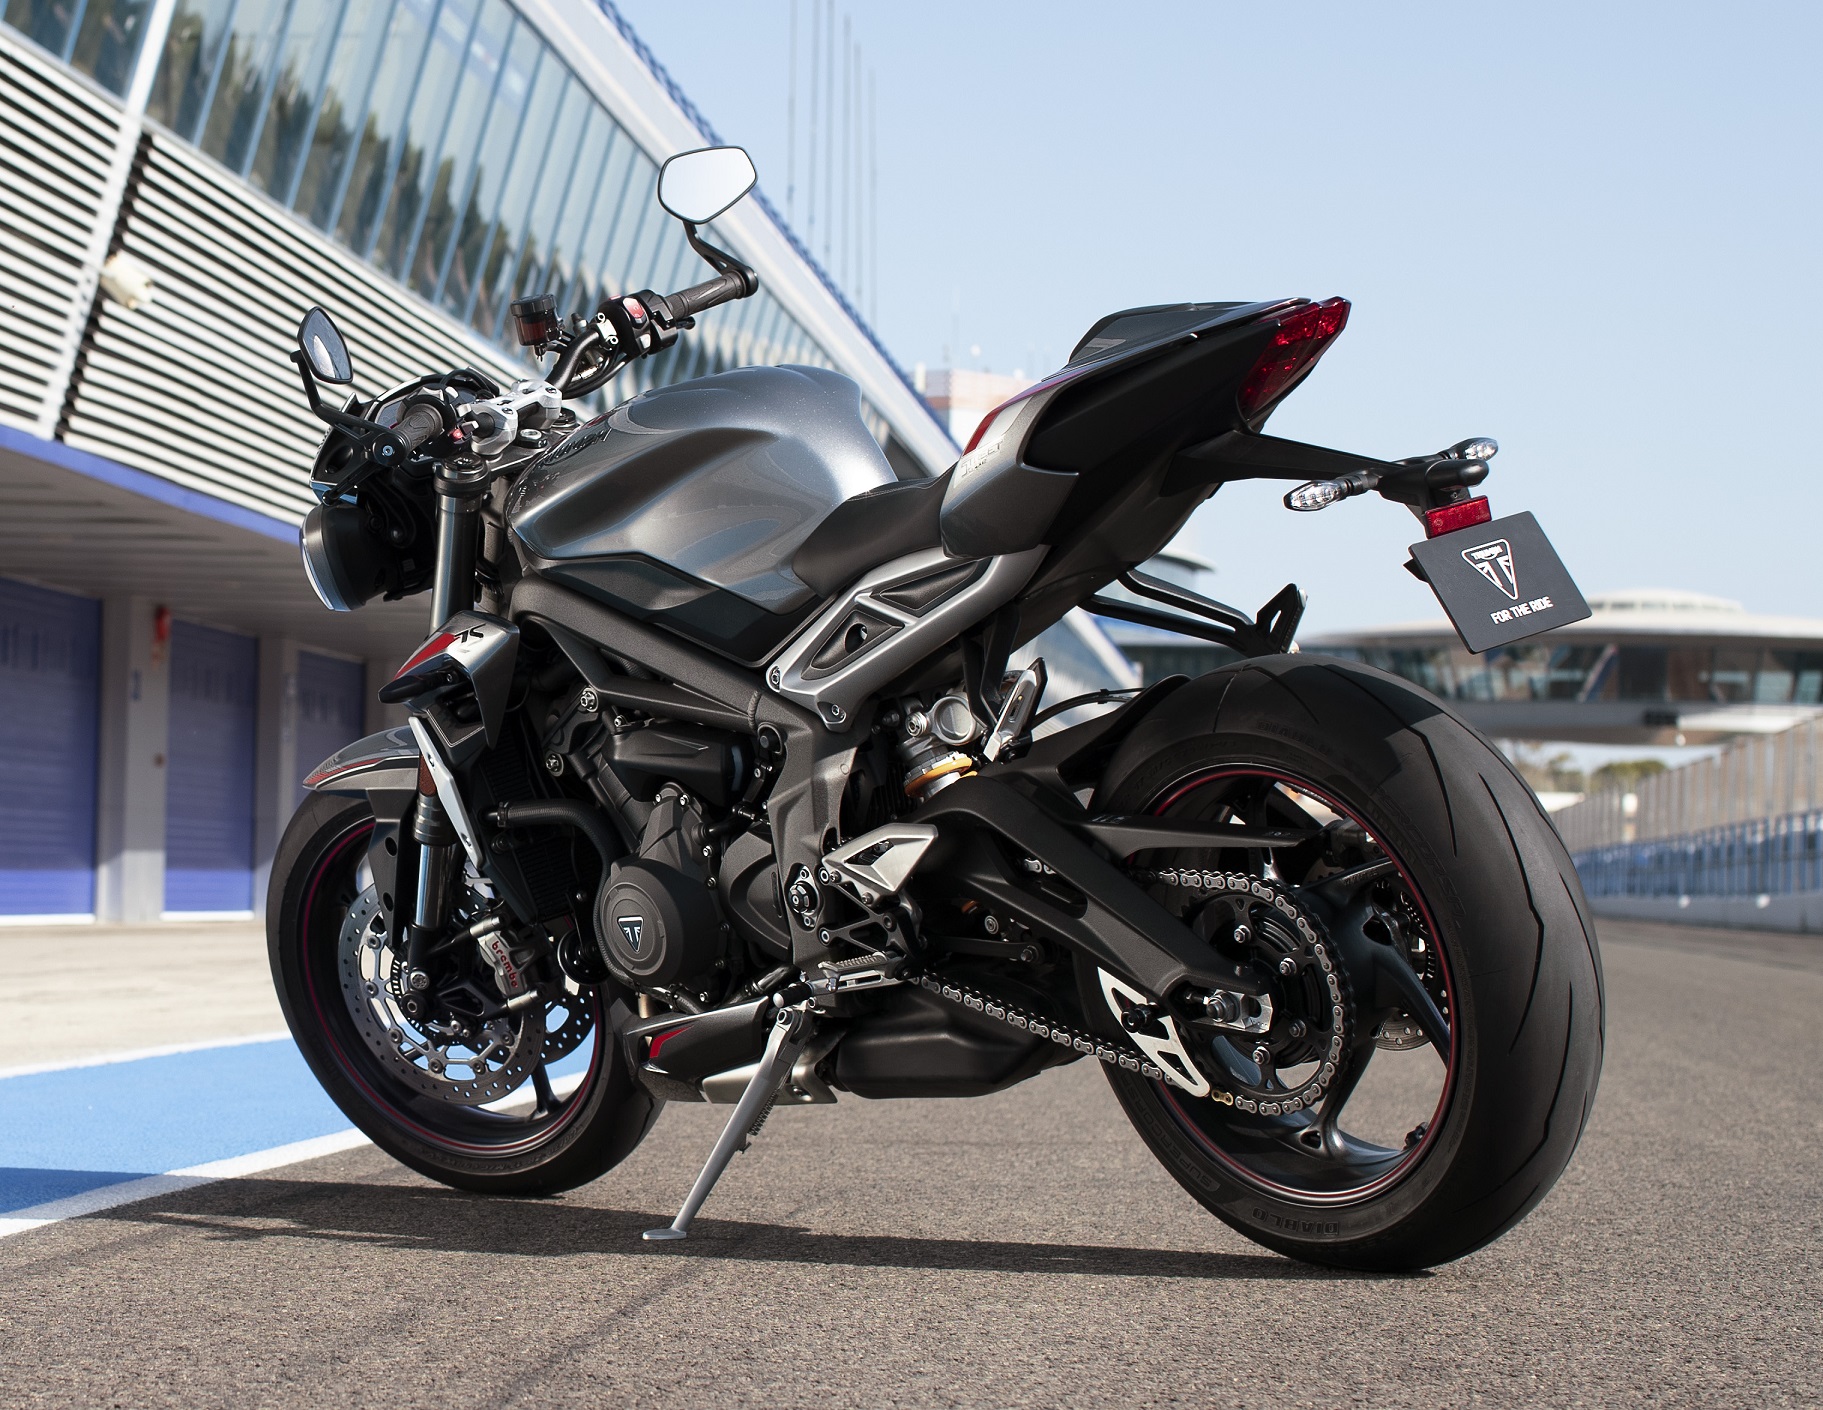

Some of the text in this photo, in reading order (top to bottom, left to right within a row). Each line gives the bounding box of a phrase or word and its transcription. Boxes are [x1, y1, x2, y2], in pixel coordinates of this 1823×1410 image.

[1490, 596, 1554, 625] FOR THE RIDE
[491, 940, 520, 989] brembo
[1120, 1073, 1213, 1189] SUPERCORSA
[1252, 1206, 1340, 1235] DIABLO
